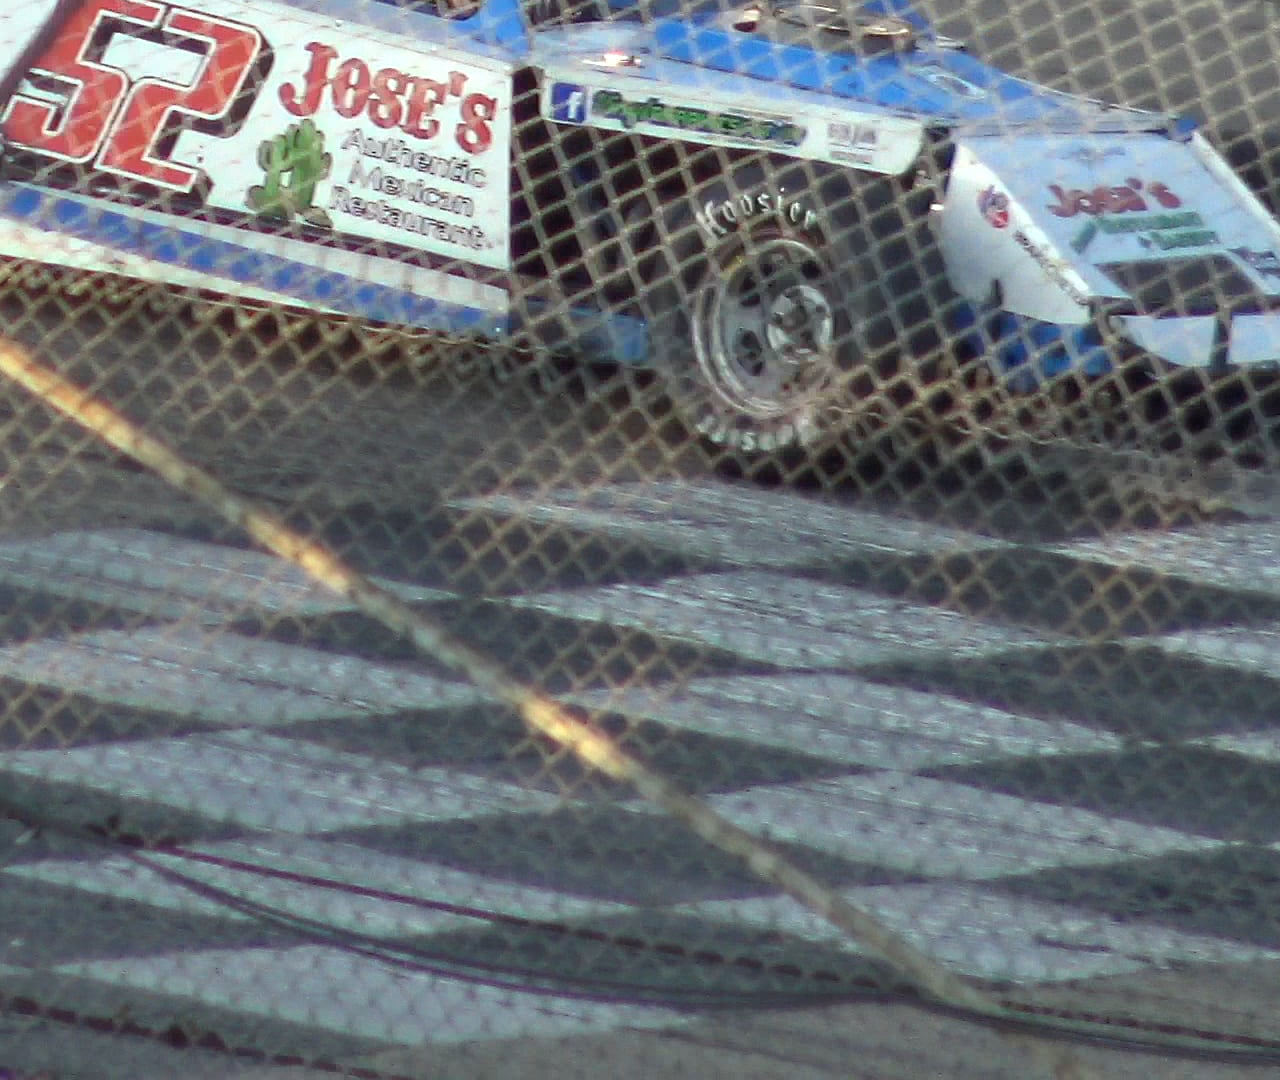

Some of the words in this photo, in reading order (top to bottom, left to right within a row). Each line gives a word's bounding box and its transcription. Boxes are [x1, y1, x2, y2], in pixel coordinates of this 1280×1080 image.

[277, 40, 499, 156] JOSE'S
[340, 128, 488, 189] Authentic
[347, 160, 475, 218] Mexican
